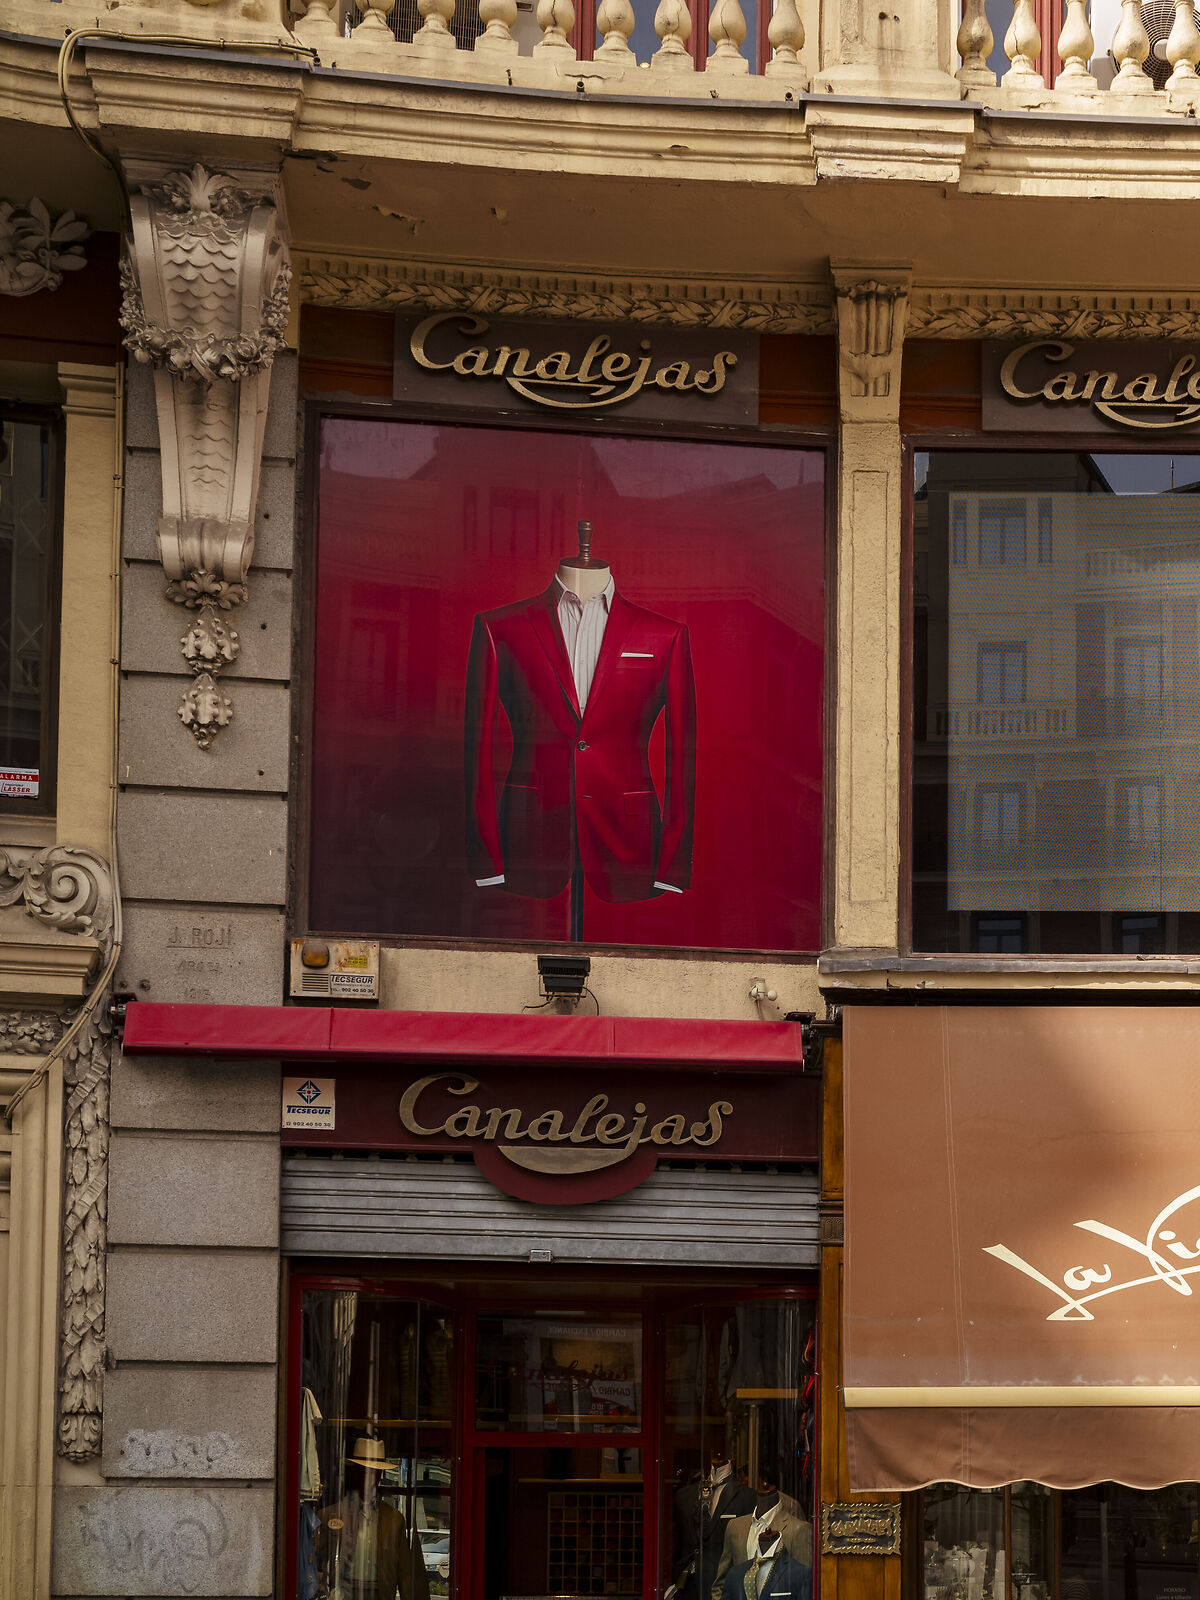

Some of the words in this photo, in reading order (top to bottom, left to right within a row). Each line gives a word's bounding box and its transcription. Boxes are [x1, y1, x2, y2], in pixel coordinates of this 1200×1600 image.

[410, 313, 738, 408] Canalejas
[0, 773, 33, 781] ALARMA
[330, 974, 375, 984] TECSEGUR
[286, 1105, 332, 1115] TECSEGUR
[400, 1072, 734, 1174] Canalejas
[981, 1243, 1112, 1321] La
